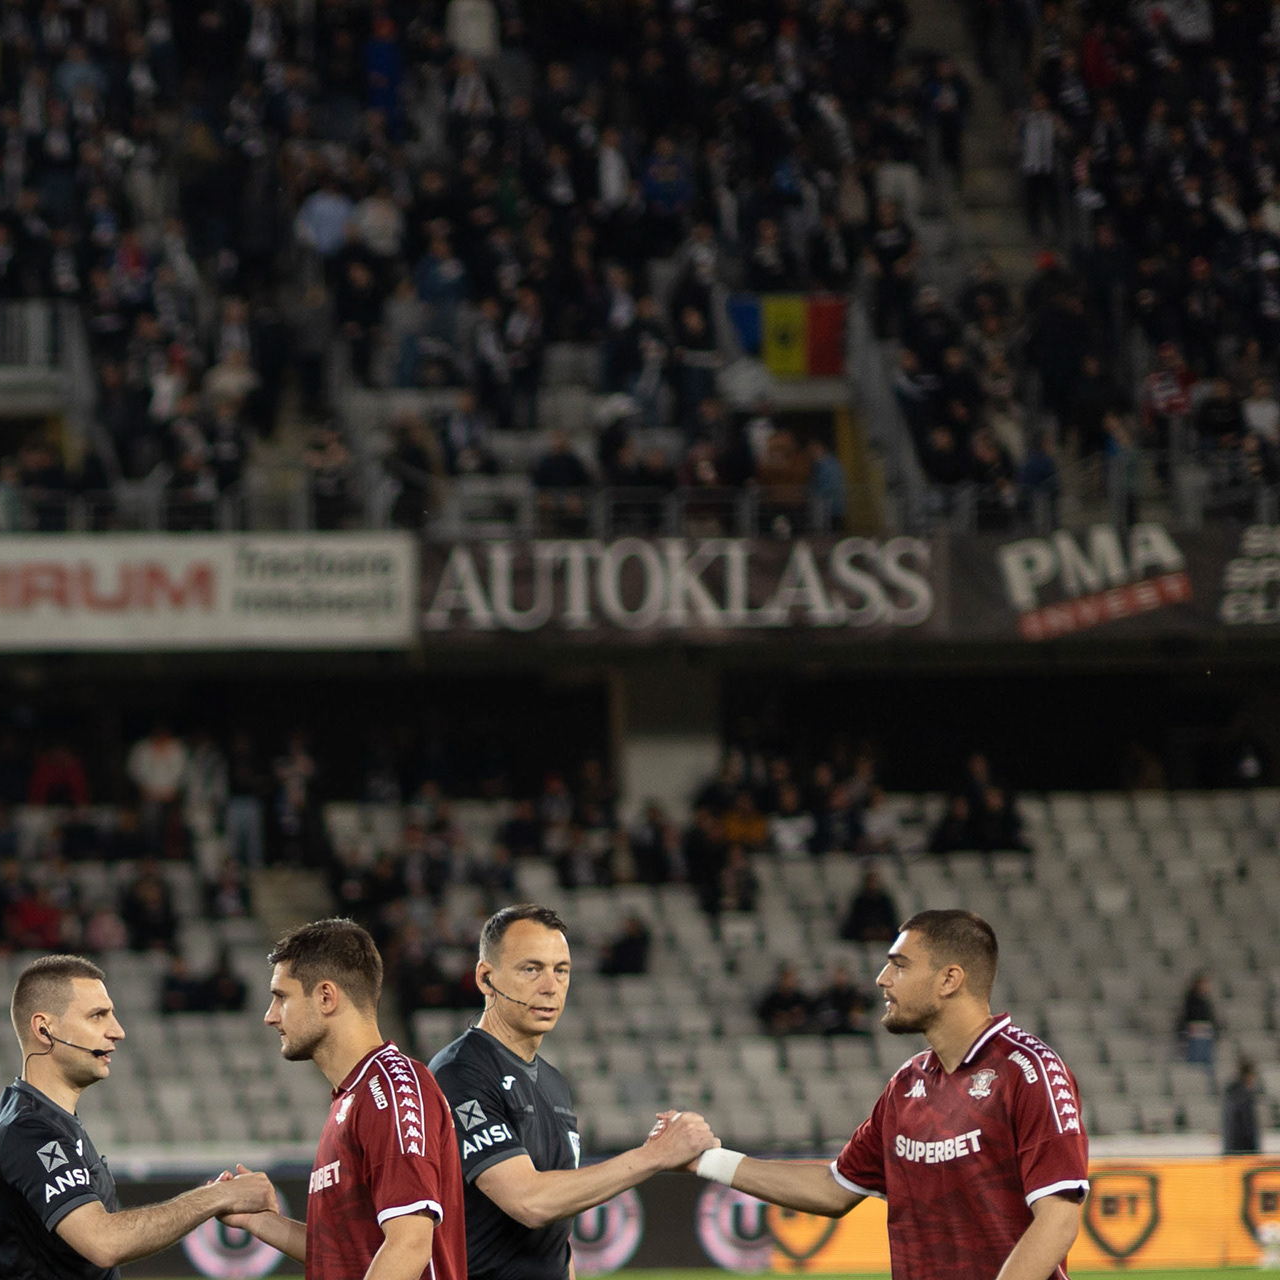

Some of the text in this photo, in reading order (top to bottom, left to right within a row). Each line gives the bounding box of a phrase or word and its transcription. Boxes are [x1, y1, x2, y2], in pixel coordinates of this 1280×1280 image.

[424, 536, 936, 632] AUTOKLASS
[995, 521, 1186, 612] PMA
[463, 1122, 513, 1160] ANSI
[895, 1128, 982, 1164] SUPERBET
[45, 1167, 91, 1204] ANSI
